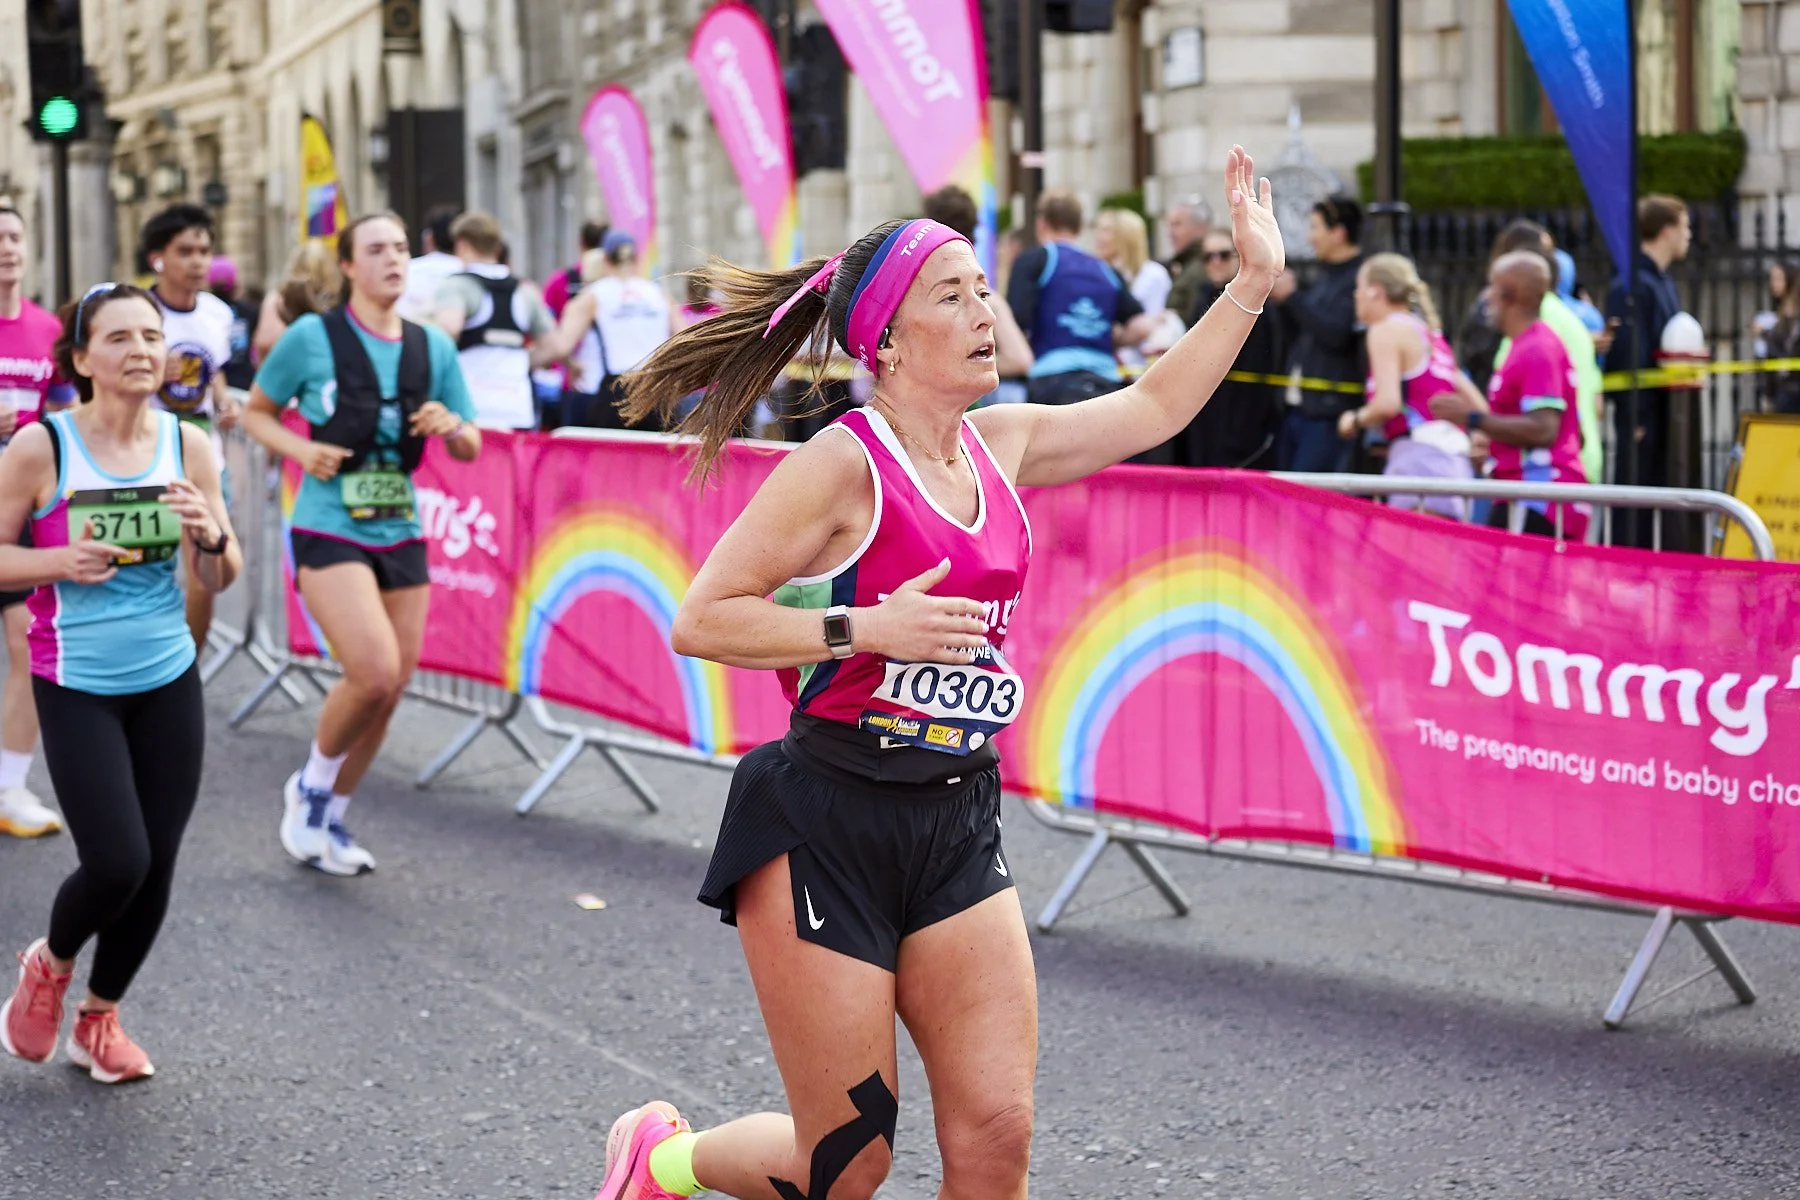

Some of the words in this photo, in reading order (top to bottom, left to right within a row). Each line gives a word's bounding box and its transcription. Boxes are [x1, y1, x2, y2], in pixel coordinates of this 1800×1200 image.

[900, 223, 936, 257] Team
[944, 645, 991, 660] ANNE
[890, 666, 1017, 718] 10303
[931, 728, 943, 736] NO
[1415, 718, 1459, 751] The
[1463, 733, 1596, 784] pregnancy
[1602, 757, 1656, 788] and
[1664, 760, 1739, 805] baby
